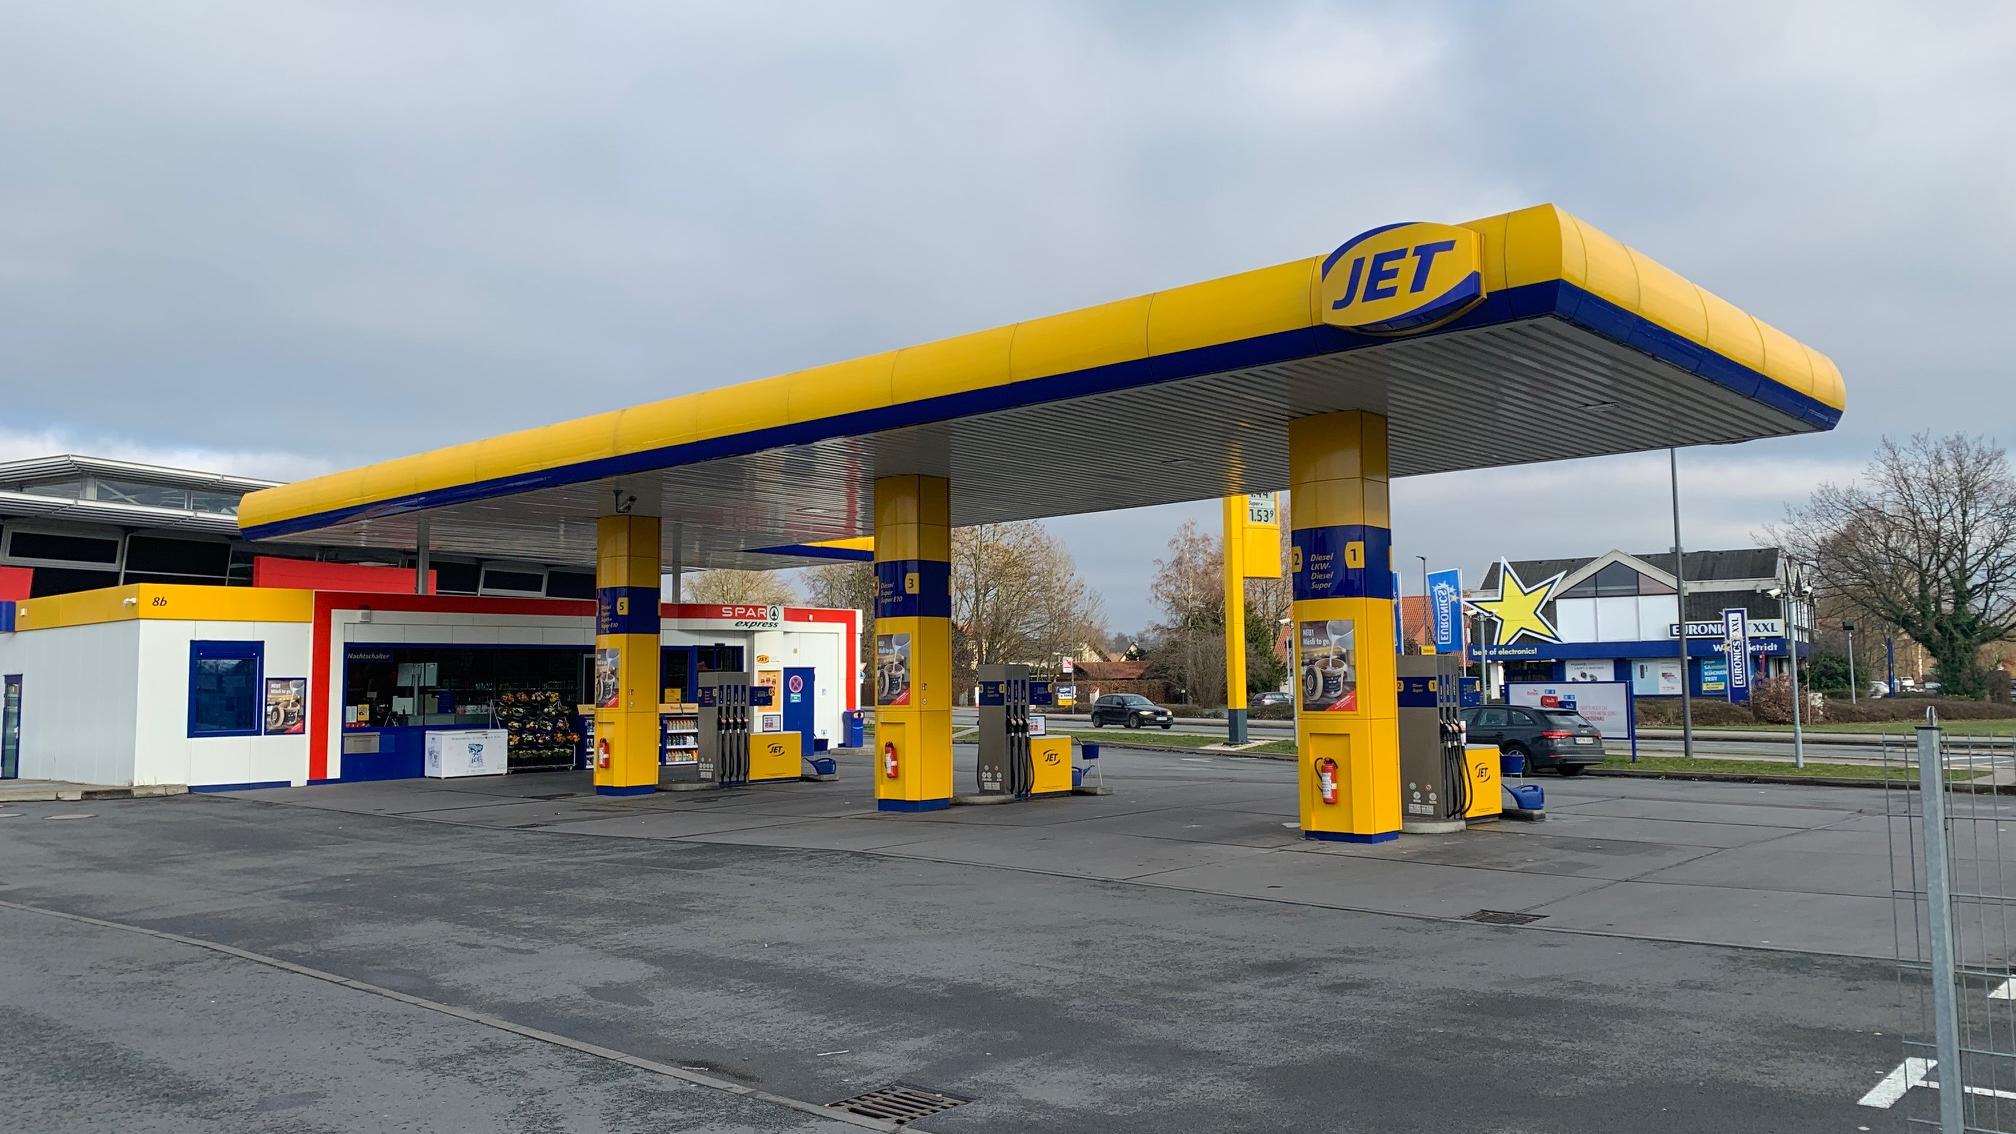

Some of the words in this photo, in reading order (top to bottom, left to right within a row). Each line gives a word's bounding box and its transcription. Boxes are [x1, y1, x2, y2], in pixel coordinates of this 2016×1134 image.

[1332, 240, 1456, 310] JET
[1294, 553, 1300, 565] 2
[1310, 553, 1334, 562] Diesel
[1350, 548, 1357, 562] 1
[1311, 563, 1331, 571] LKW-
[1311, 572, 1334, 580] Diesel
[908, 578, 914, 588] 3
[1311, 582, 1332, 590] Super
[152, 596, 167, 606] 8b
[619, 602, 624, 611] 5
[722, 607, 767, 618] SPAR
[1753, 623, 1778, 632] XXL
[1732, 641, 1744, 686] EURONICS
[770, 746, 782, 754] JET
[1045, 753, 1059, 762] JET
[1477, 767, 1488, 778] JET
